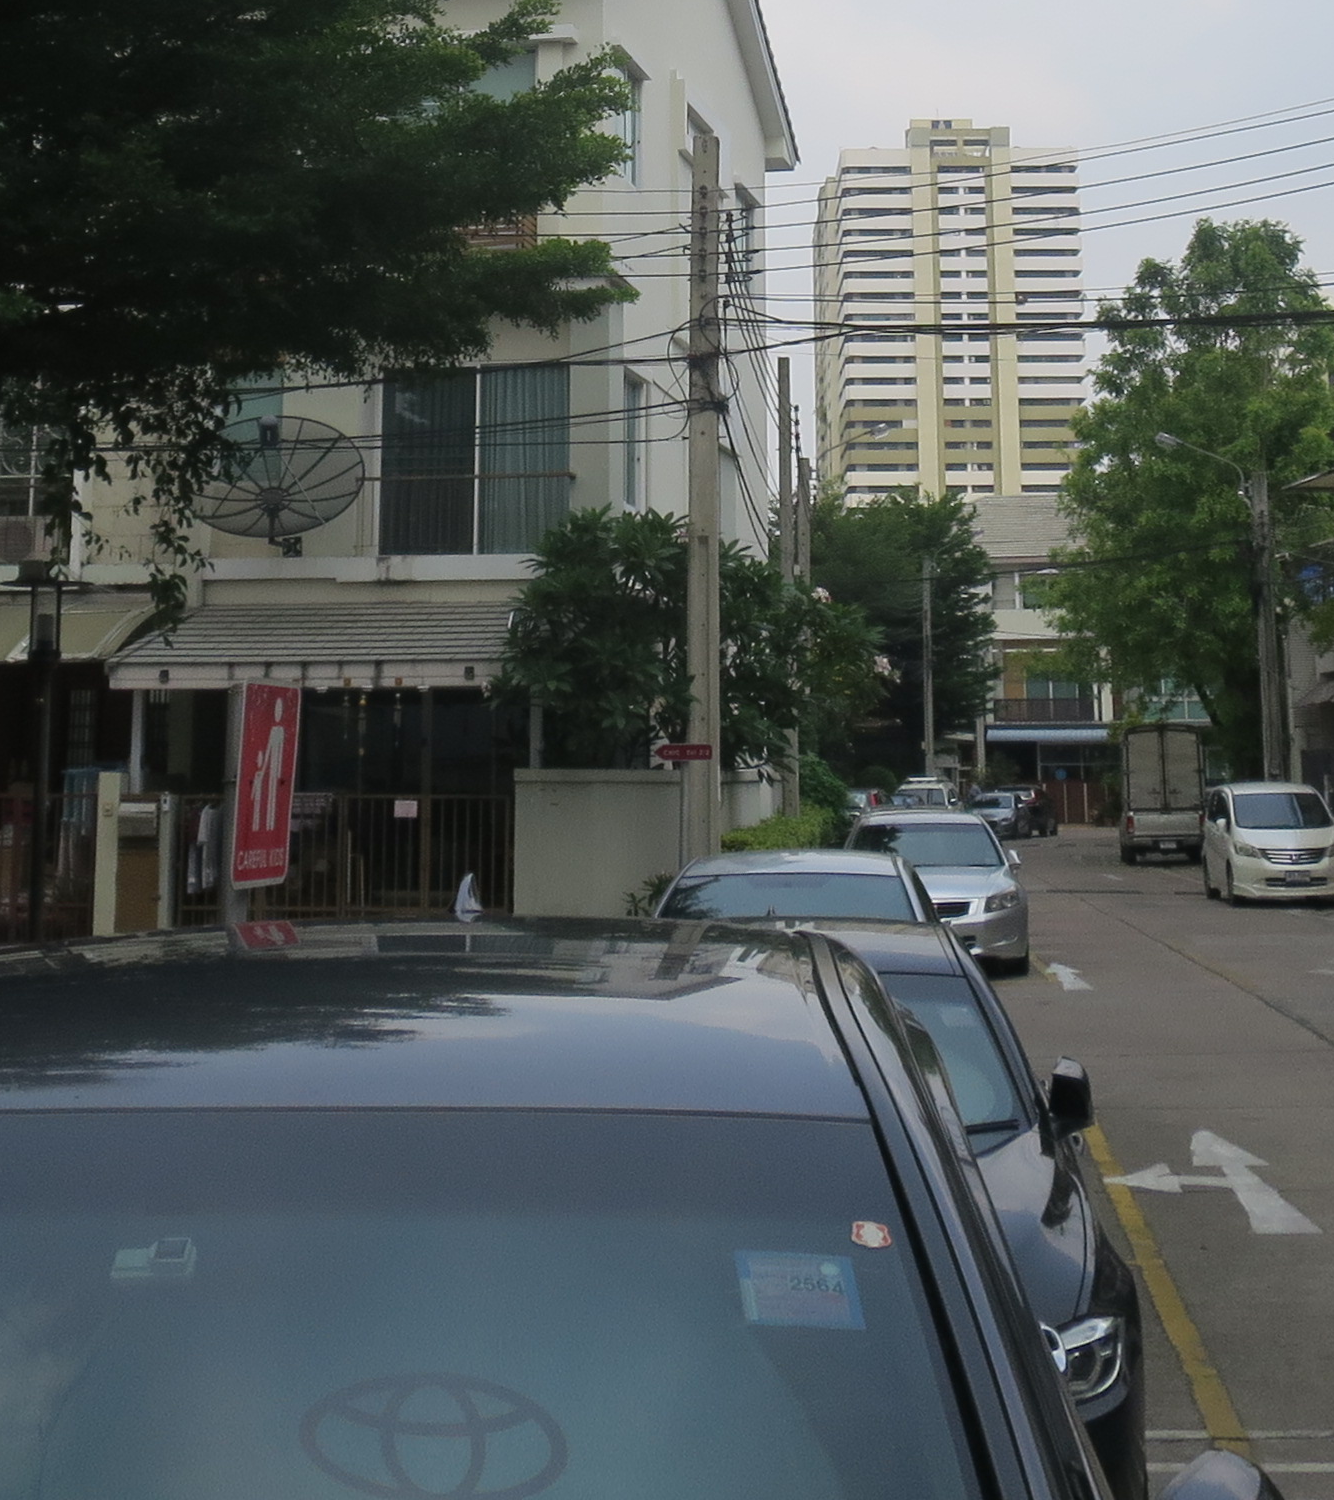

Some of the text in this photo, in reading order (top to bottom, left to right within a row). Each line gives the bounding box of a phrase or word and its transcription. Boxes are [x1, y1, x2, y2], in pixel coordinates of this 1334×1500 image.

[236, 848, 285, 871] CAREFUL KIDS
[789, 1276, 844, 1294] 2564
